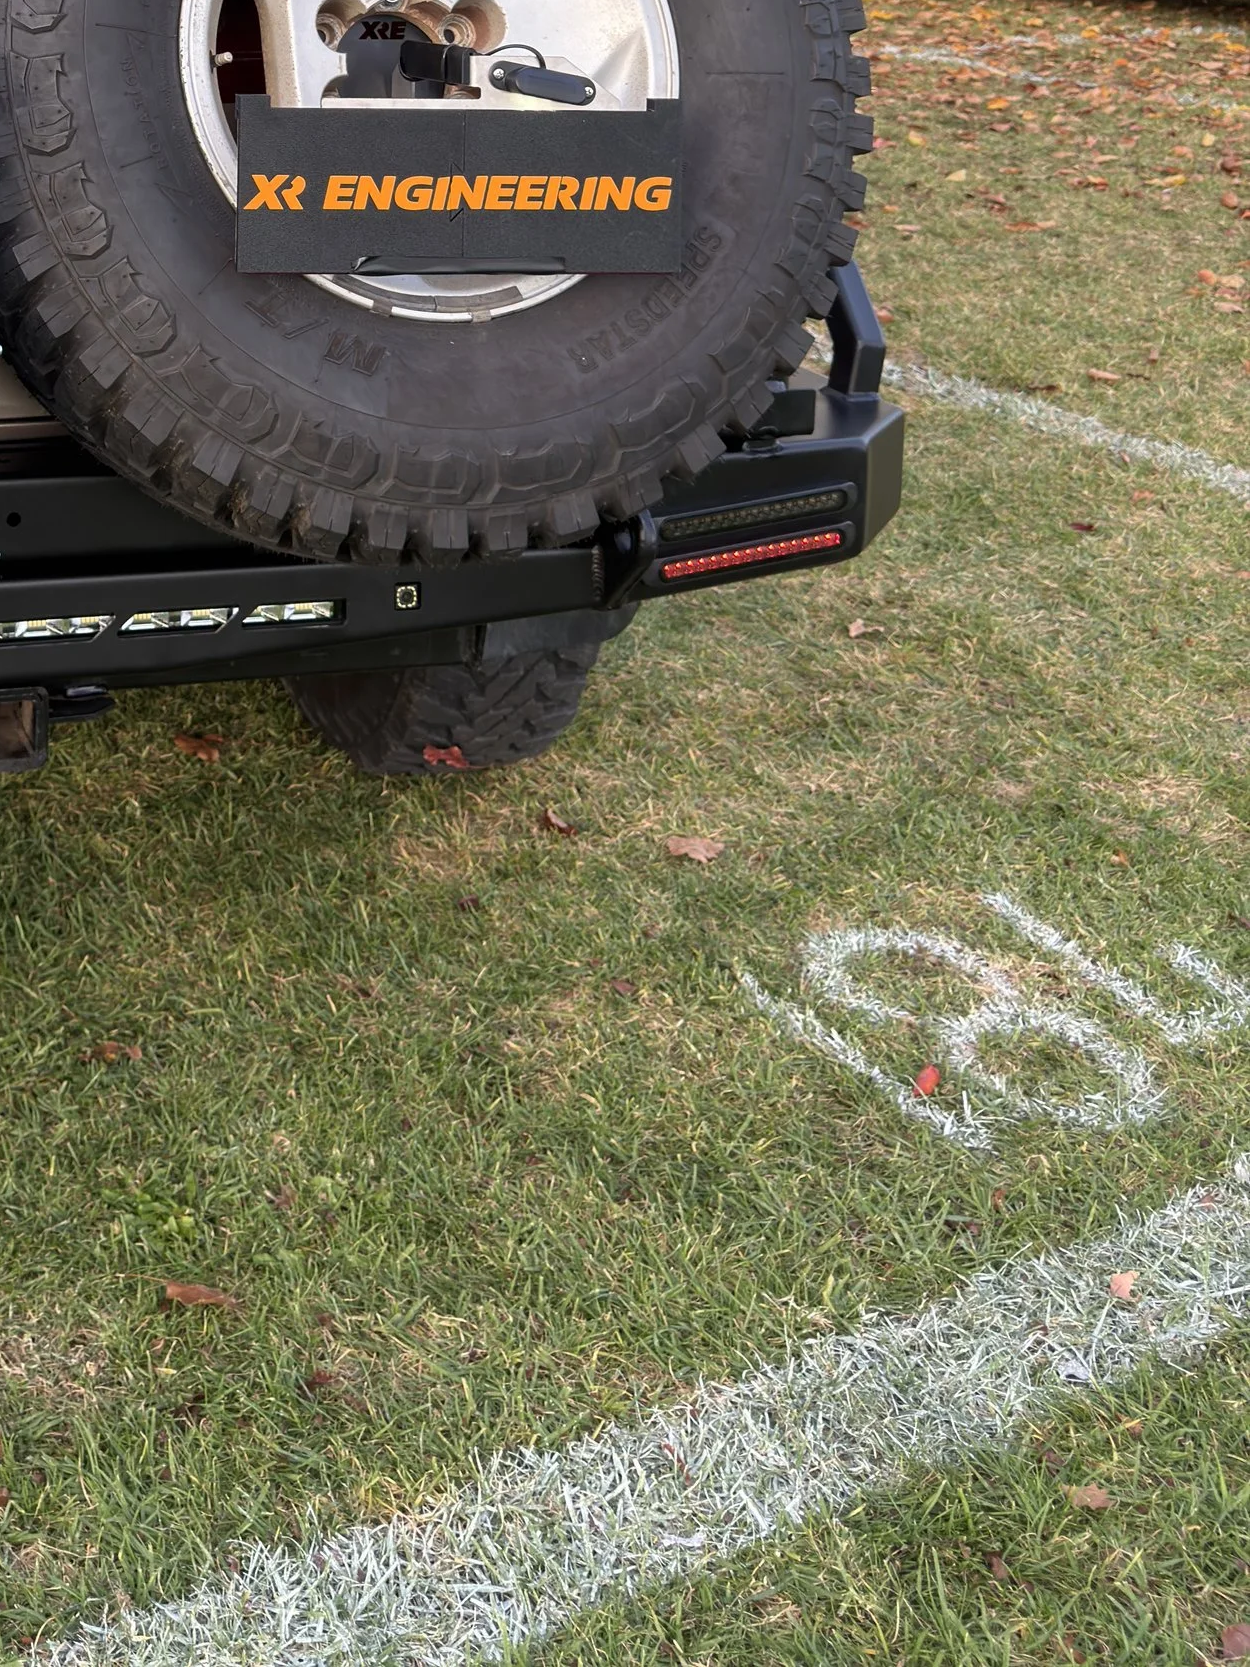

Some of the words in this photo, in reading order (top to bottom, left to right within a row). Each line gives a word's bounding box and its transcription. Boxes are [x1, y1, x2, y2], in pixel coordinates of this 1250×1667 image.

[358, 21, 407, 39] XRE
[243, 174, 306, 211] XR
[322, 175, 672, 211] ENGINEERING
